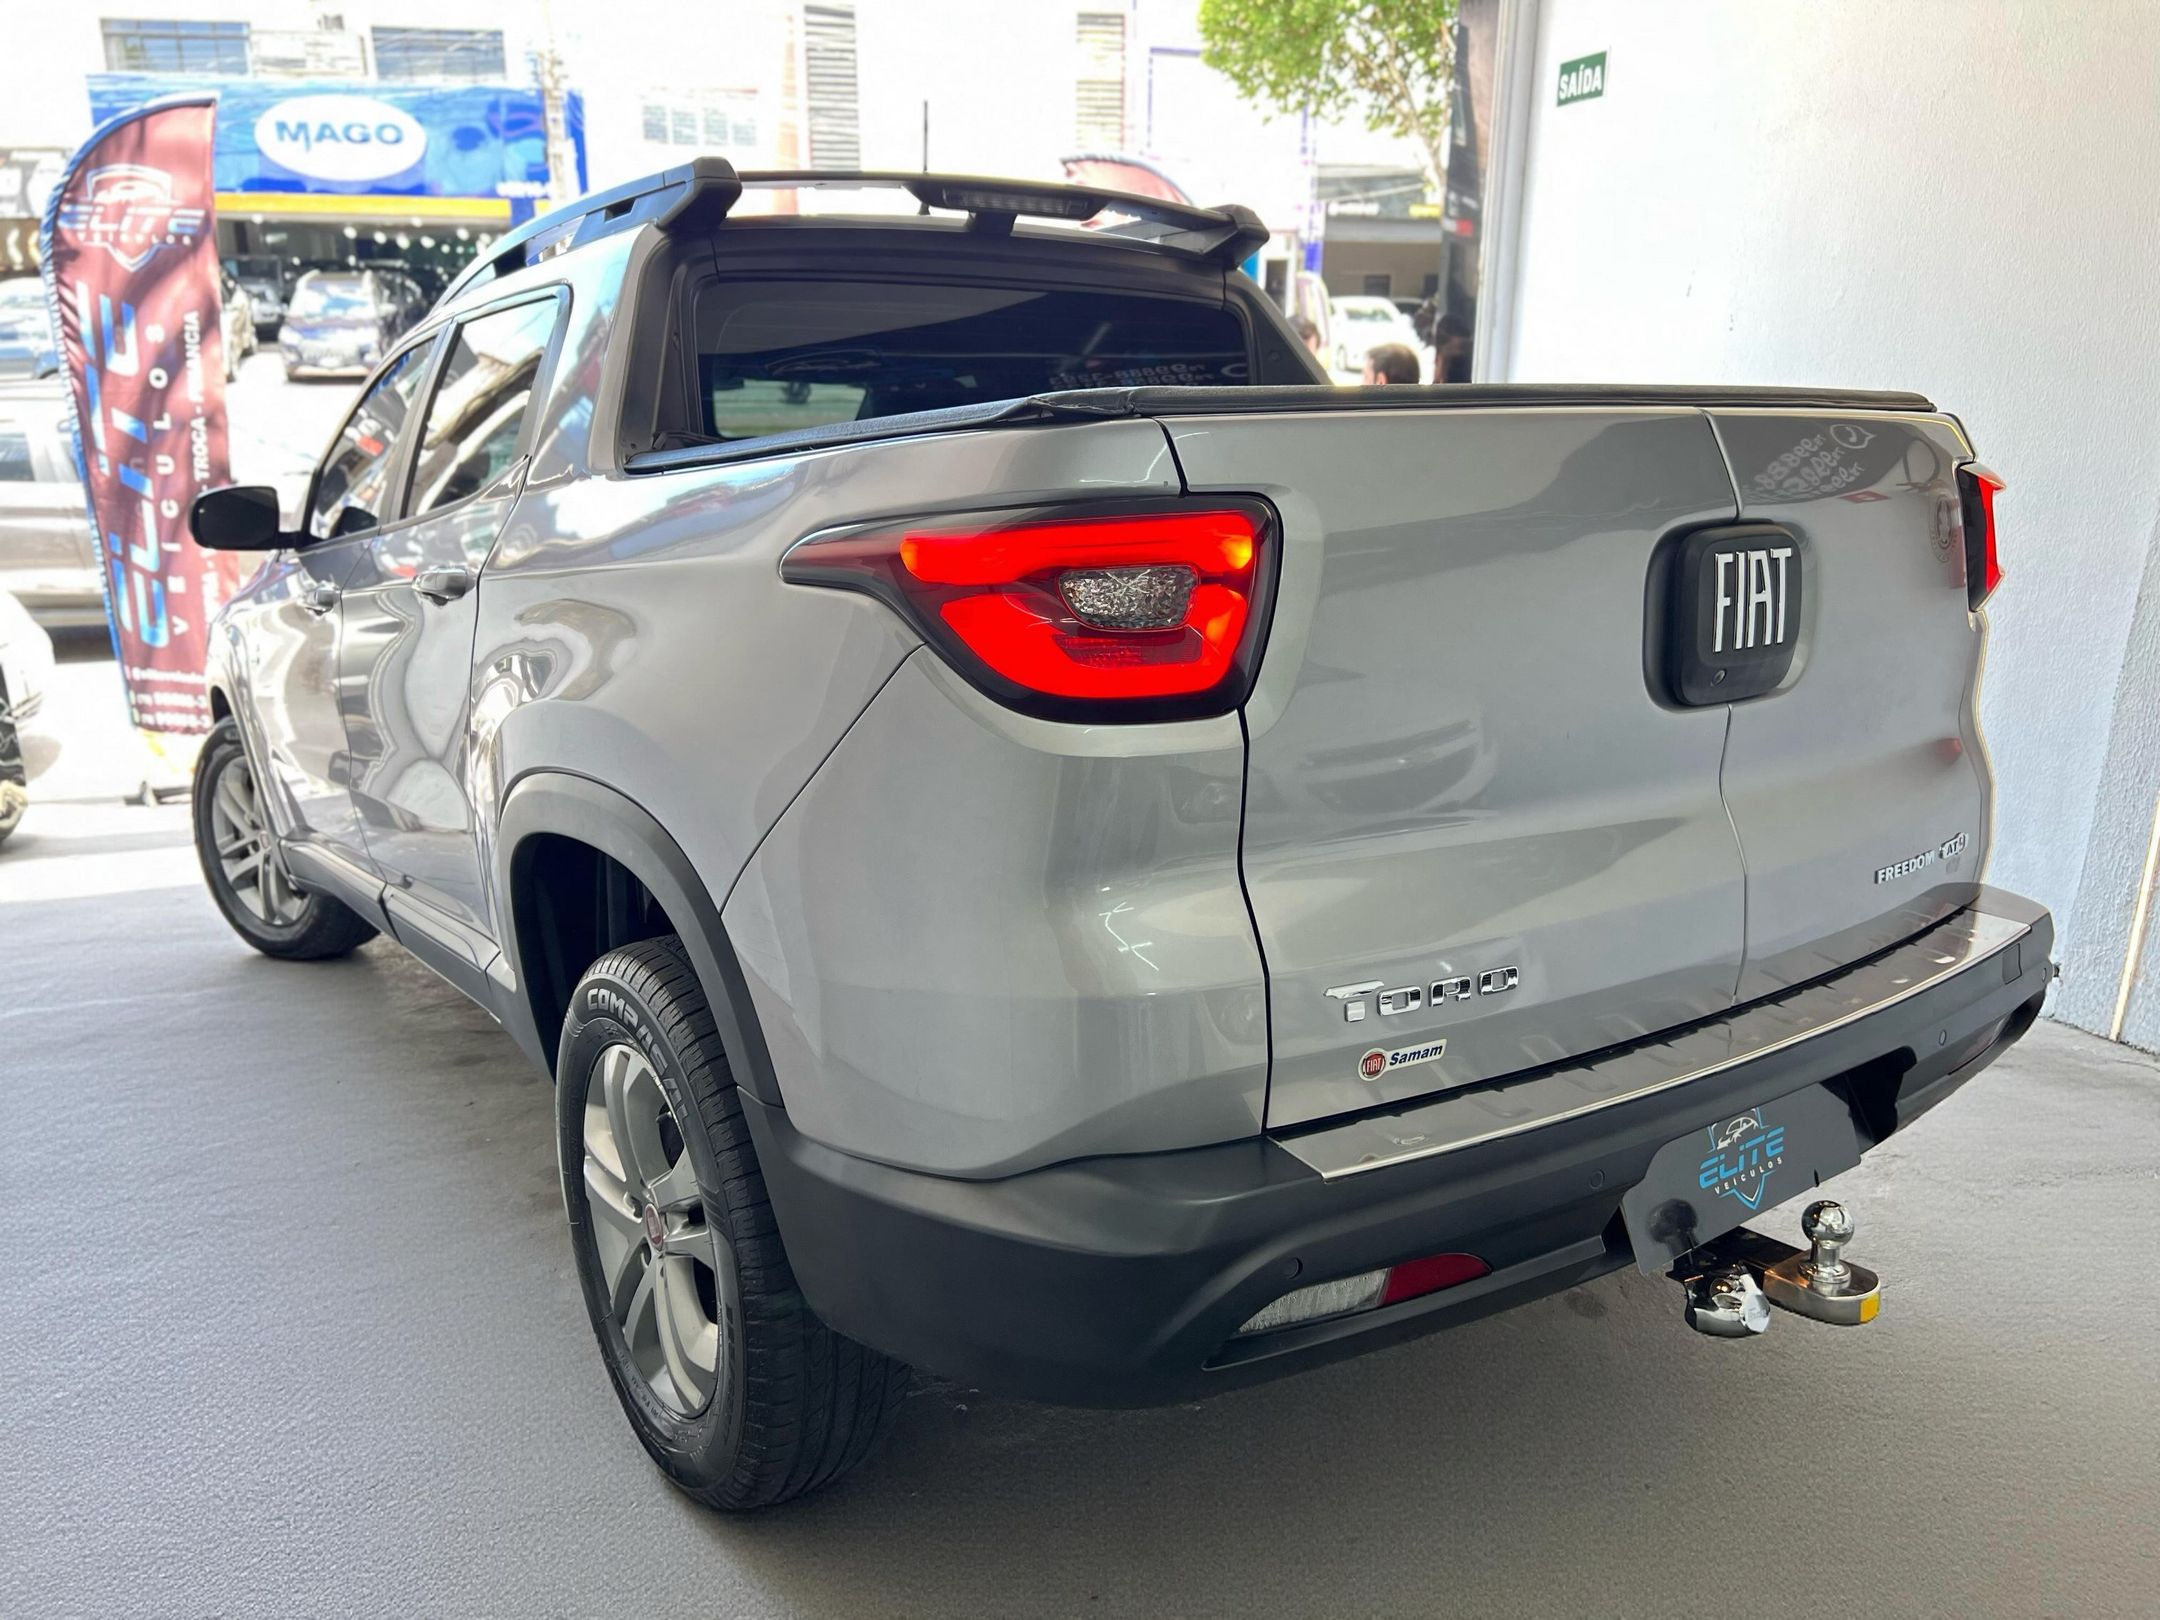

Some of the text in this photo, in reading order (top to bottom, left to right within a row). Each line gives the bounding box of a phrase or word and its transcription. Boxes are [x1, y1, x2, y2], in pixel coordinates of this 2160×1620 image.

[1559, 63, 1602, 100] SAÍDA
[275, 120, 404, 151] MAGO
[58, 204, 206, 236] ELITE
[190, 416, 210, 482] TROCA
[1713, 547, 1792, 653] FIAT
[1875, 850, 1935, 884] FREEDOM
[1323, 966, 1519, 1022] TORO
[1366, 1045, 1443, 1073] FIAT Samam
[1699, 1127, 1784, 1189] ELITE
